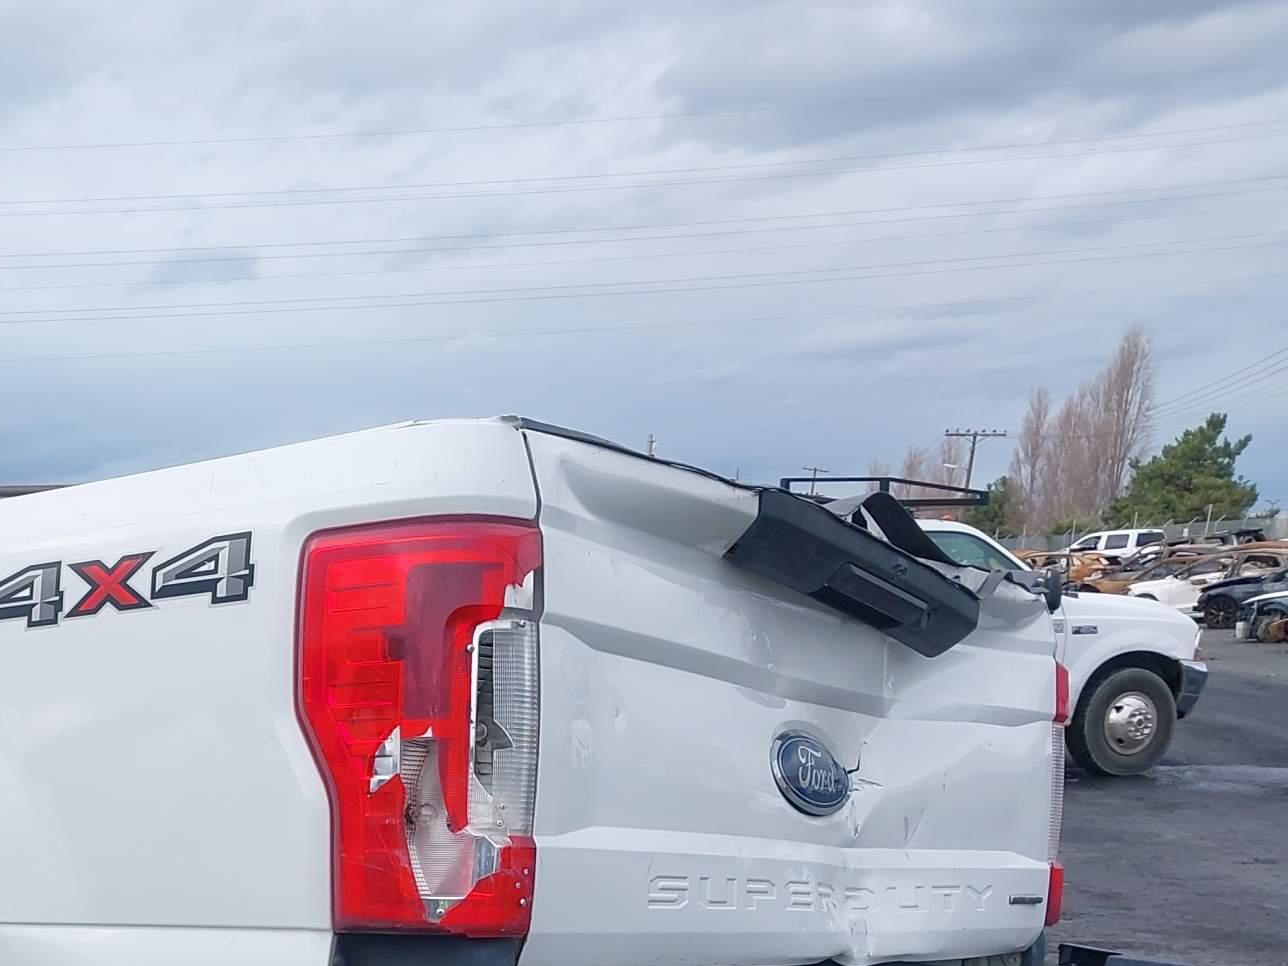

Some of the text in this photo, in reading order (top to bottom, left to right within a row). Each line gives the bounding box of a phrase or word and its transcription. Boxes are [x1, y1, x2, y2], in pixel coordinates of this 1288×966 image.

[798, 745, 841, 793] Ford
[648, 875, 993, 914] SUPER DUTY
